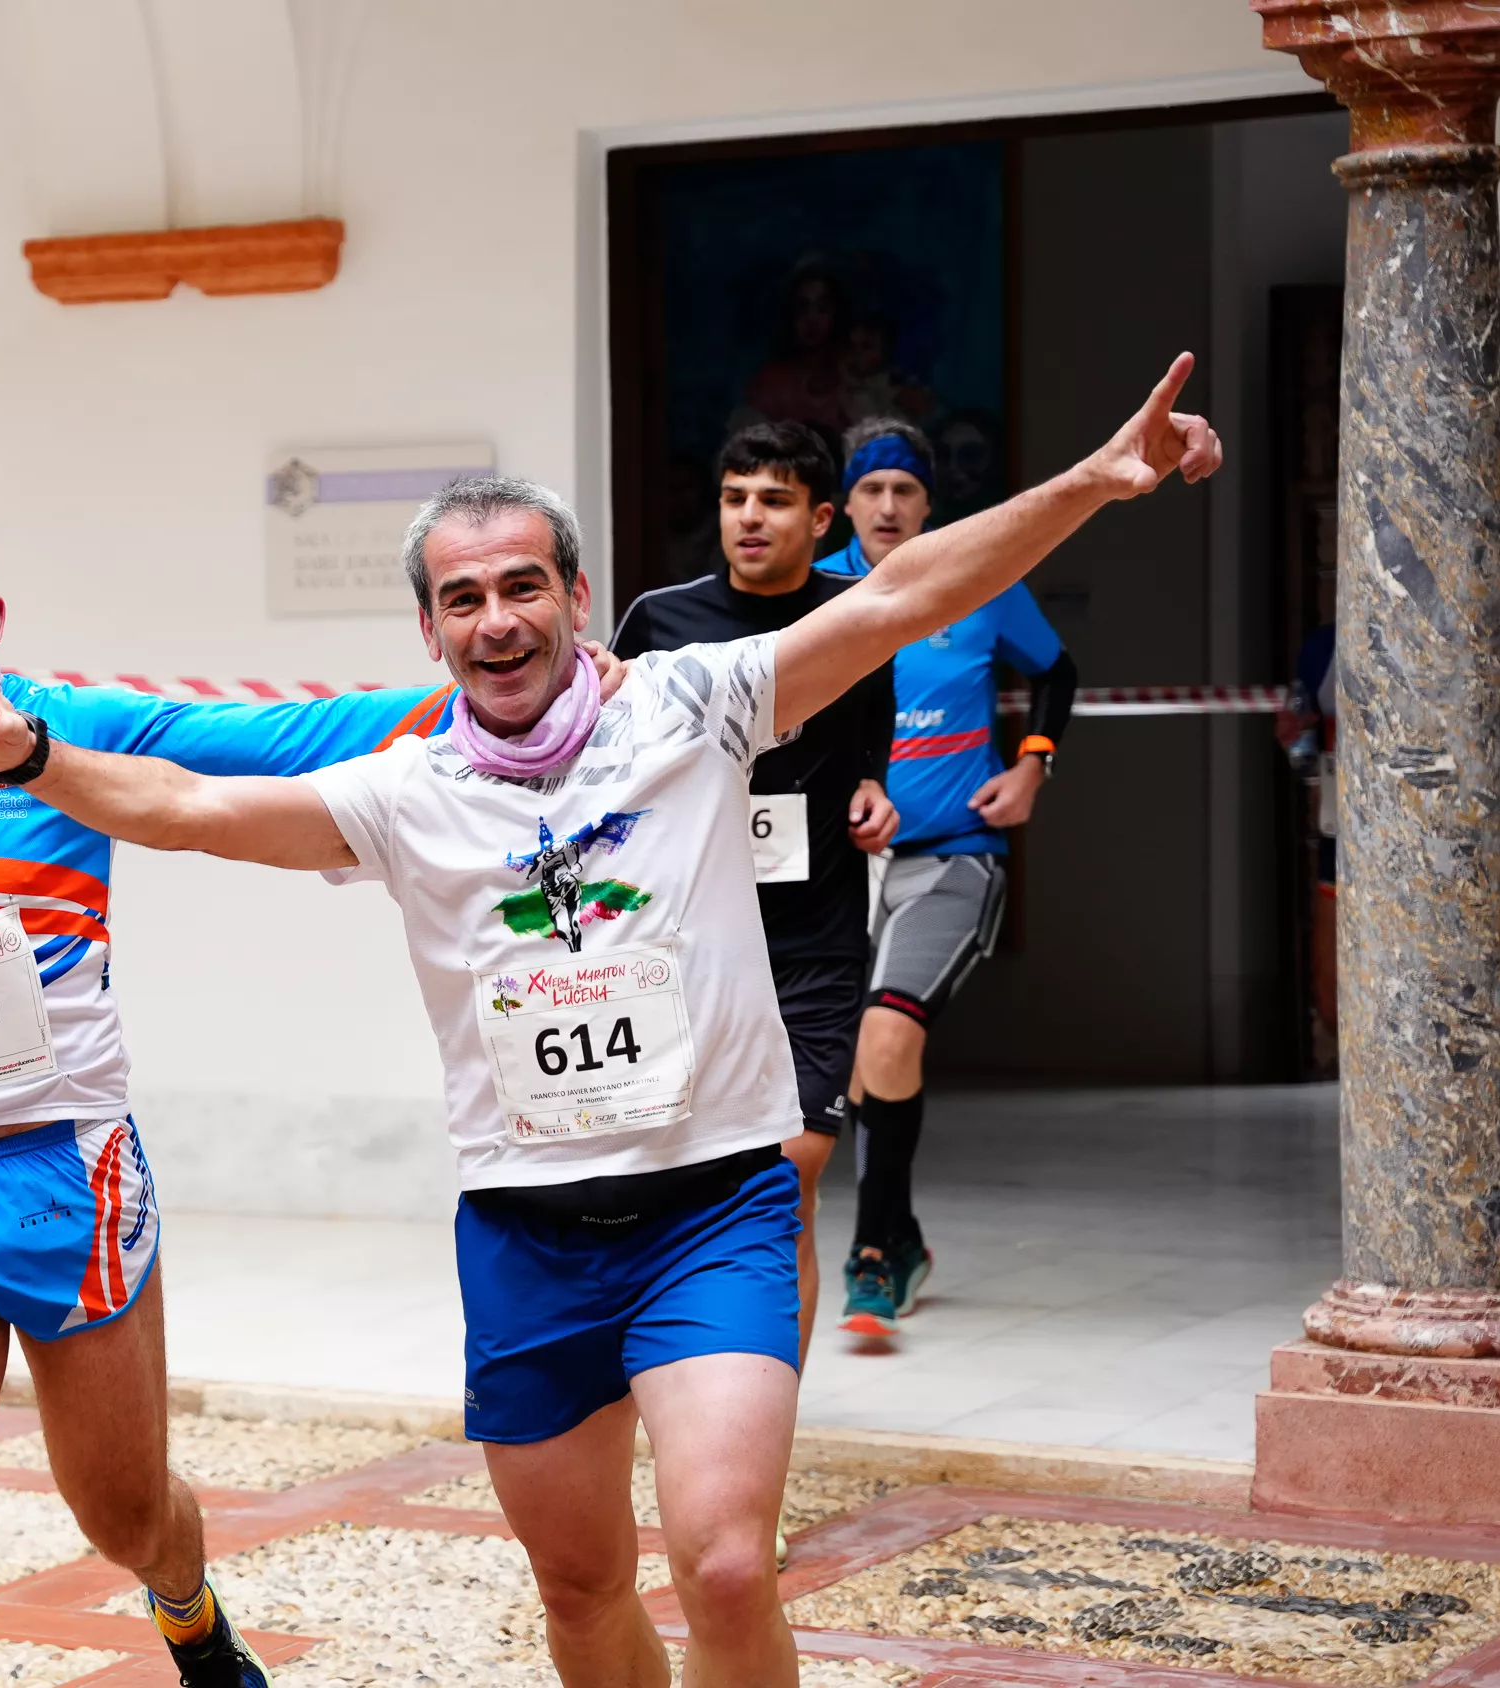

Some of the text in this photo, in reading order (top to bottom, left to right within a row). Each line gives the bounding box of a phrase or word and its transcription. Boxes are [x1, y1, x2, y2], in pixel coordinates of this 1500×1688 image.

[576, 963, 626, 982] MARATÓN
[552, 984, 616, 1007] LUCENA
[534, 1016, 642, 1076] 614
[530, 1091, 566, 1101] FRANCISCO
[567, 1086, 589, 1098] JAVIER
[589, 1081, 623, 1094] MOYANO
[576, 1095, 613, 1105] M-Hombre
[581, 1212, 639, 1225] SALOMON
